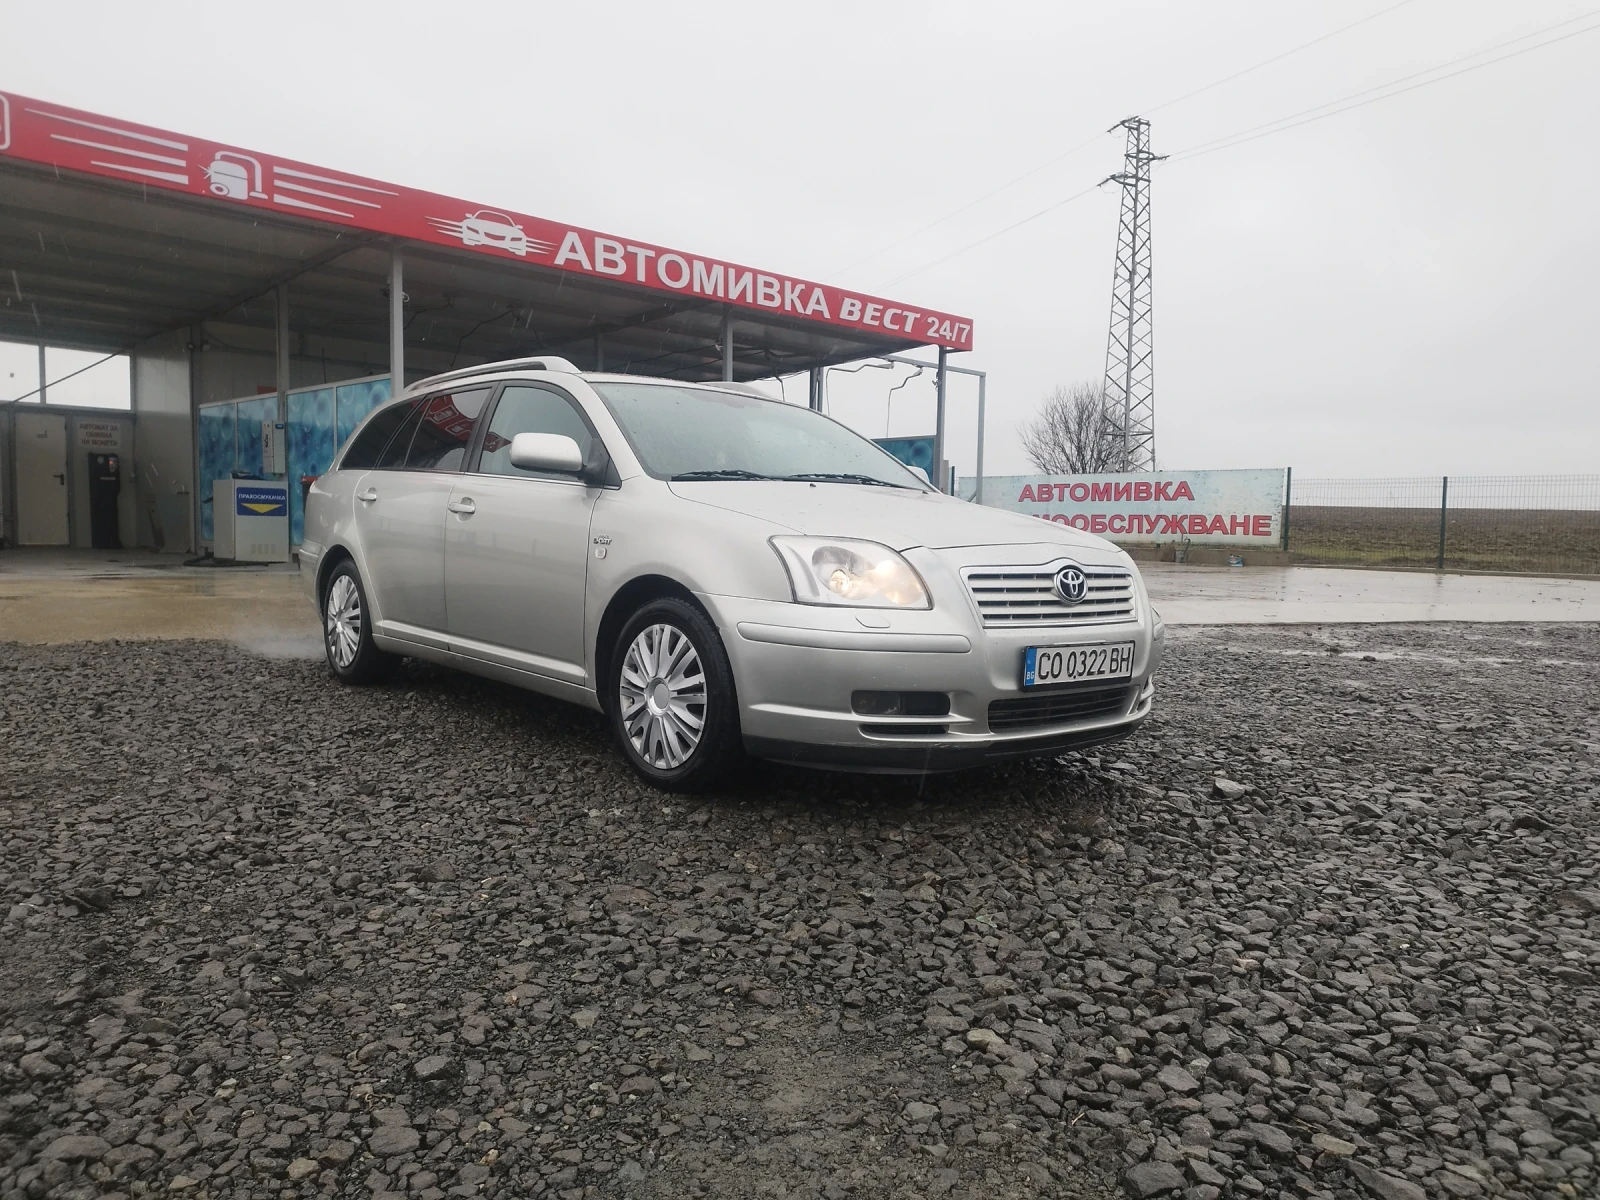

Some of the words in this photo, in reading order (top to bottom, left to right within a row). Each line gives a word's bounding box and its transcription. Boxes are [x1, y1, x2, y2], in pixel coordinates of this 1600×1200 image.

[553, 231, 831, 319] АВТОМИВКА
[839, 297, 921, 333] ВЕСТ
[926, 316, 971, 343] 24/7
[1019, 481, 1195, 502] АВТОМИВКА
[1032, 514, 1272, 536] ООБСЛУЖВАНЕ
[1038, 652, 1062, 680] CO
[1067, 649, 1107, 678] 0322
[1109, 646, 1132, 674] BH
[1026, 671, 1035, 680] BG
